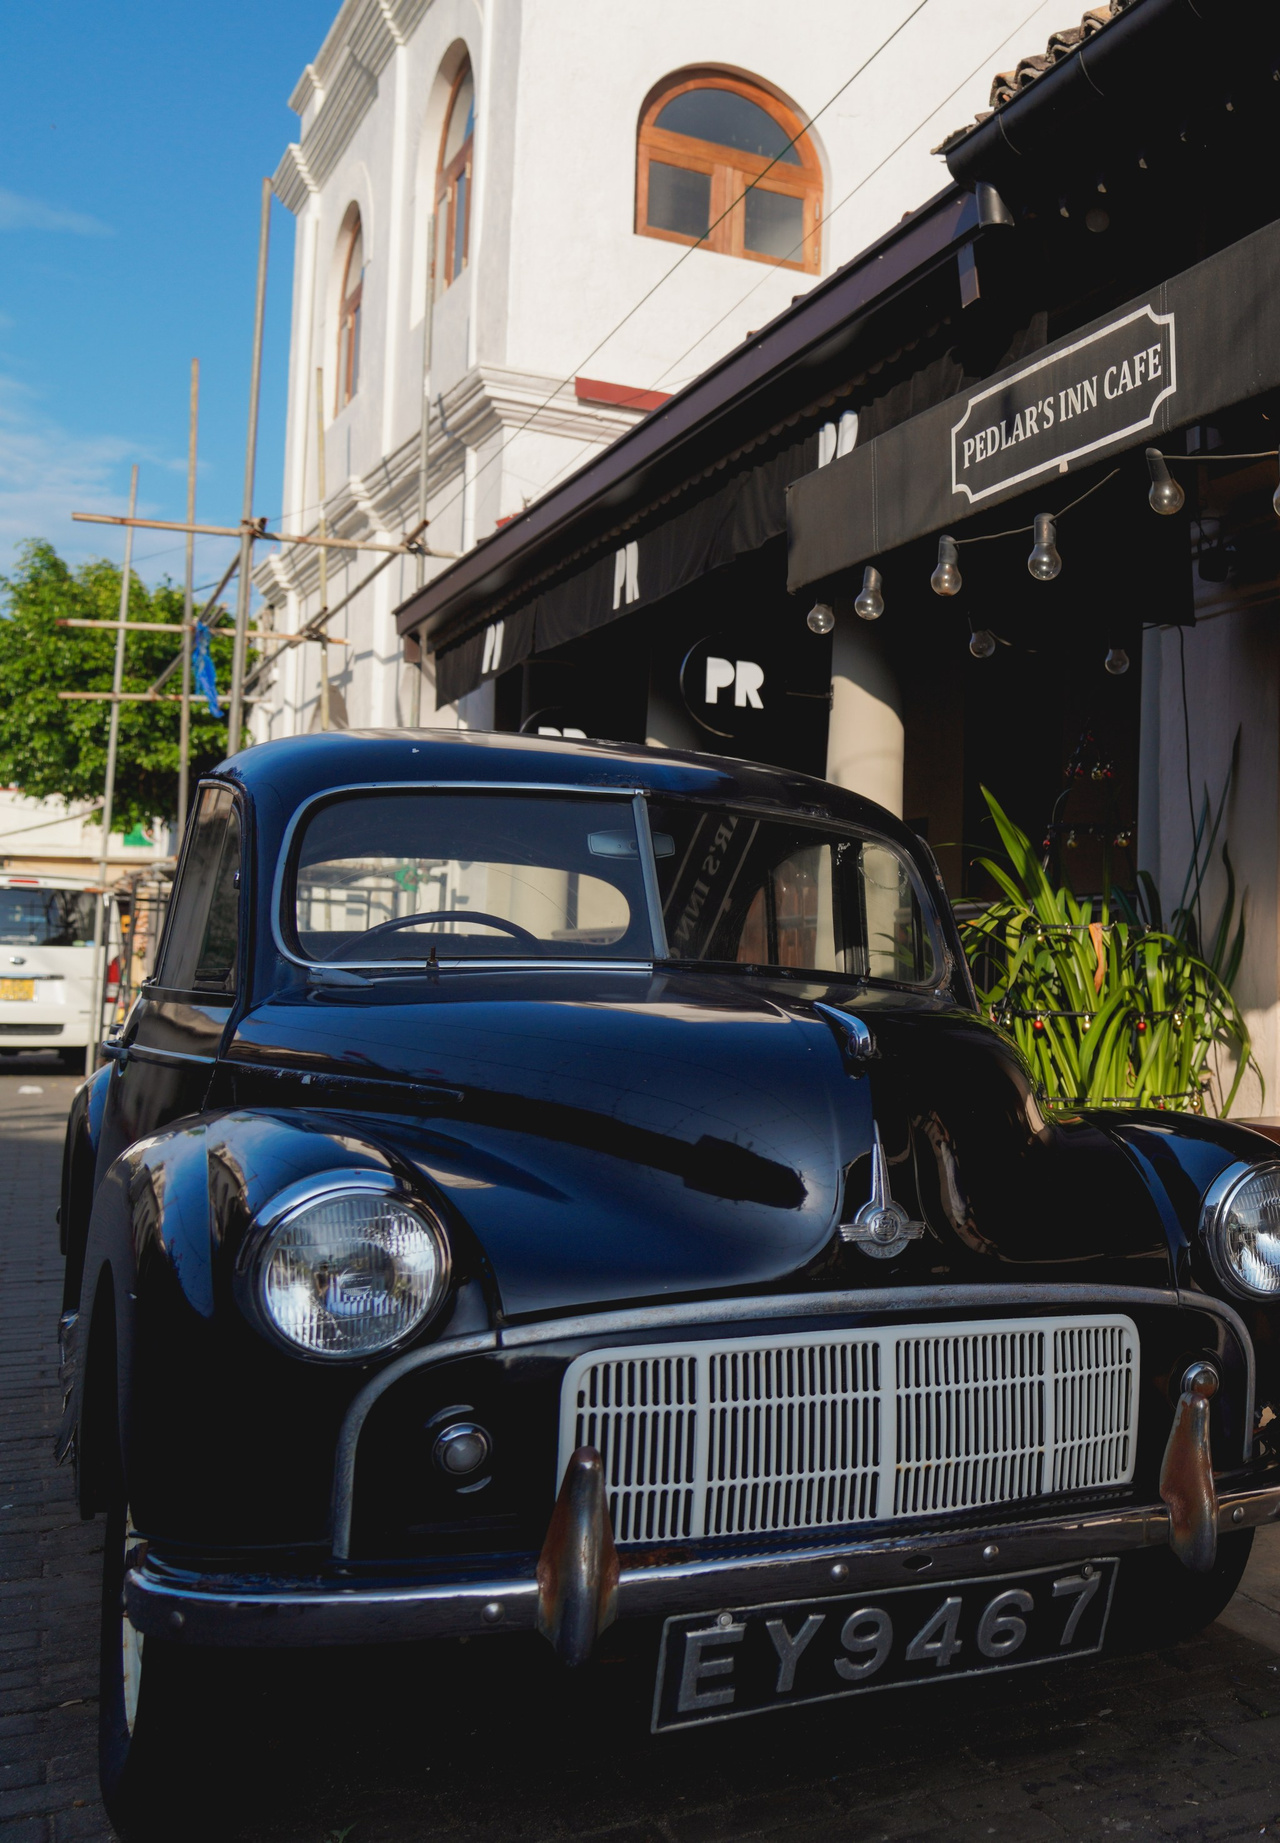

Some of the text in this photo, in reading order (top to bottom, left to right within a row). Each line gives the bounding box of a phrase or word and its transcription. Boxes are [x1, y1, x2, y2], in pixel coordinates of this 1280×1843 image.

[962, 343, 1163, 468] PEDLAR'S INN CAFE
[705, 656, 765, 709] PR
